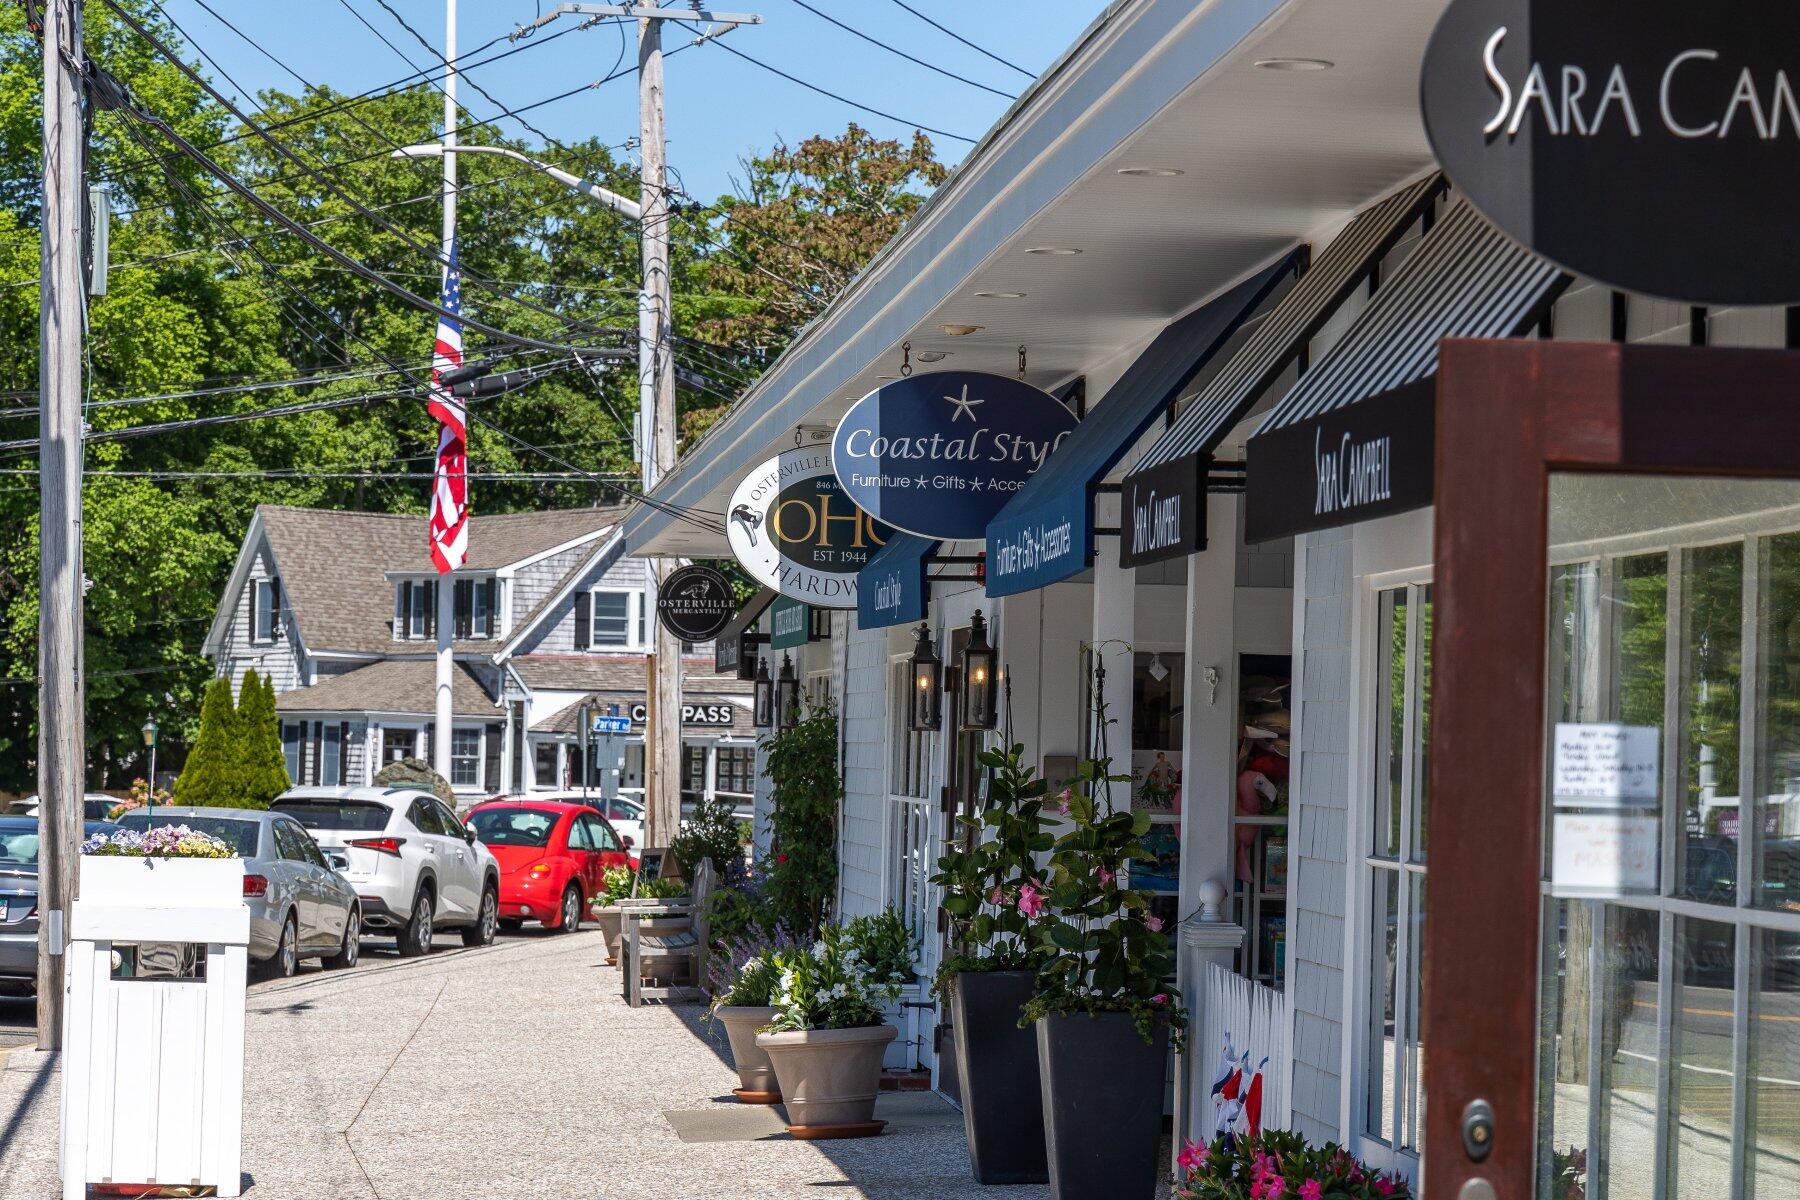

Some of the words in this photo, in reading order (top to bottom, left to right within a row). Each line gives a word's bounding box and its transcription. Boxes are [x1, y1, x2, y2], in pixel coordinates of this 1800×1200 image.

[1483, 26, 1641, 137] SARA
[846, 429, 989, 462] Coastal
[989, 431, 1071, 474] Styl
[750, 456, 821, 501] OSTERVILLE
[816, 481, 831, 490] 846
[852, 473, 911, 488] Furniture
[932, 475, 966, 490] Gifts
[988, 478, 1027, 492] Acce
[814, 550, 835, 562] EST
[840, 551, 868, 562] 1944
[770, 561, 857, 597] HARDW
[659, 599, 736, 608] OSTERVILLE
[632, 705, 731, 723] CPASS
